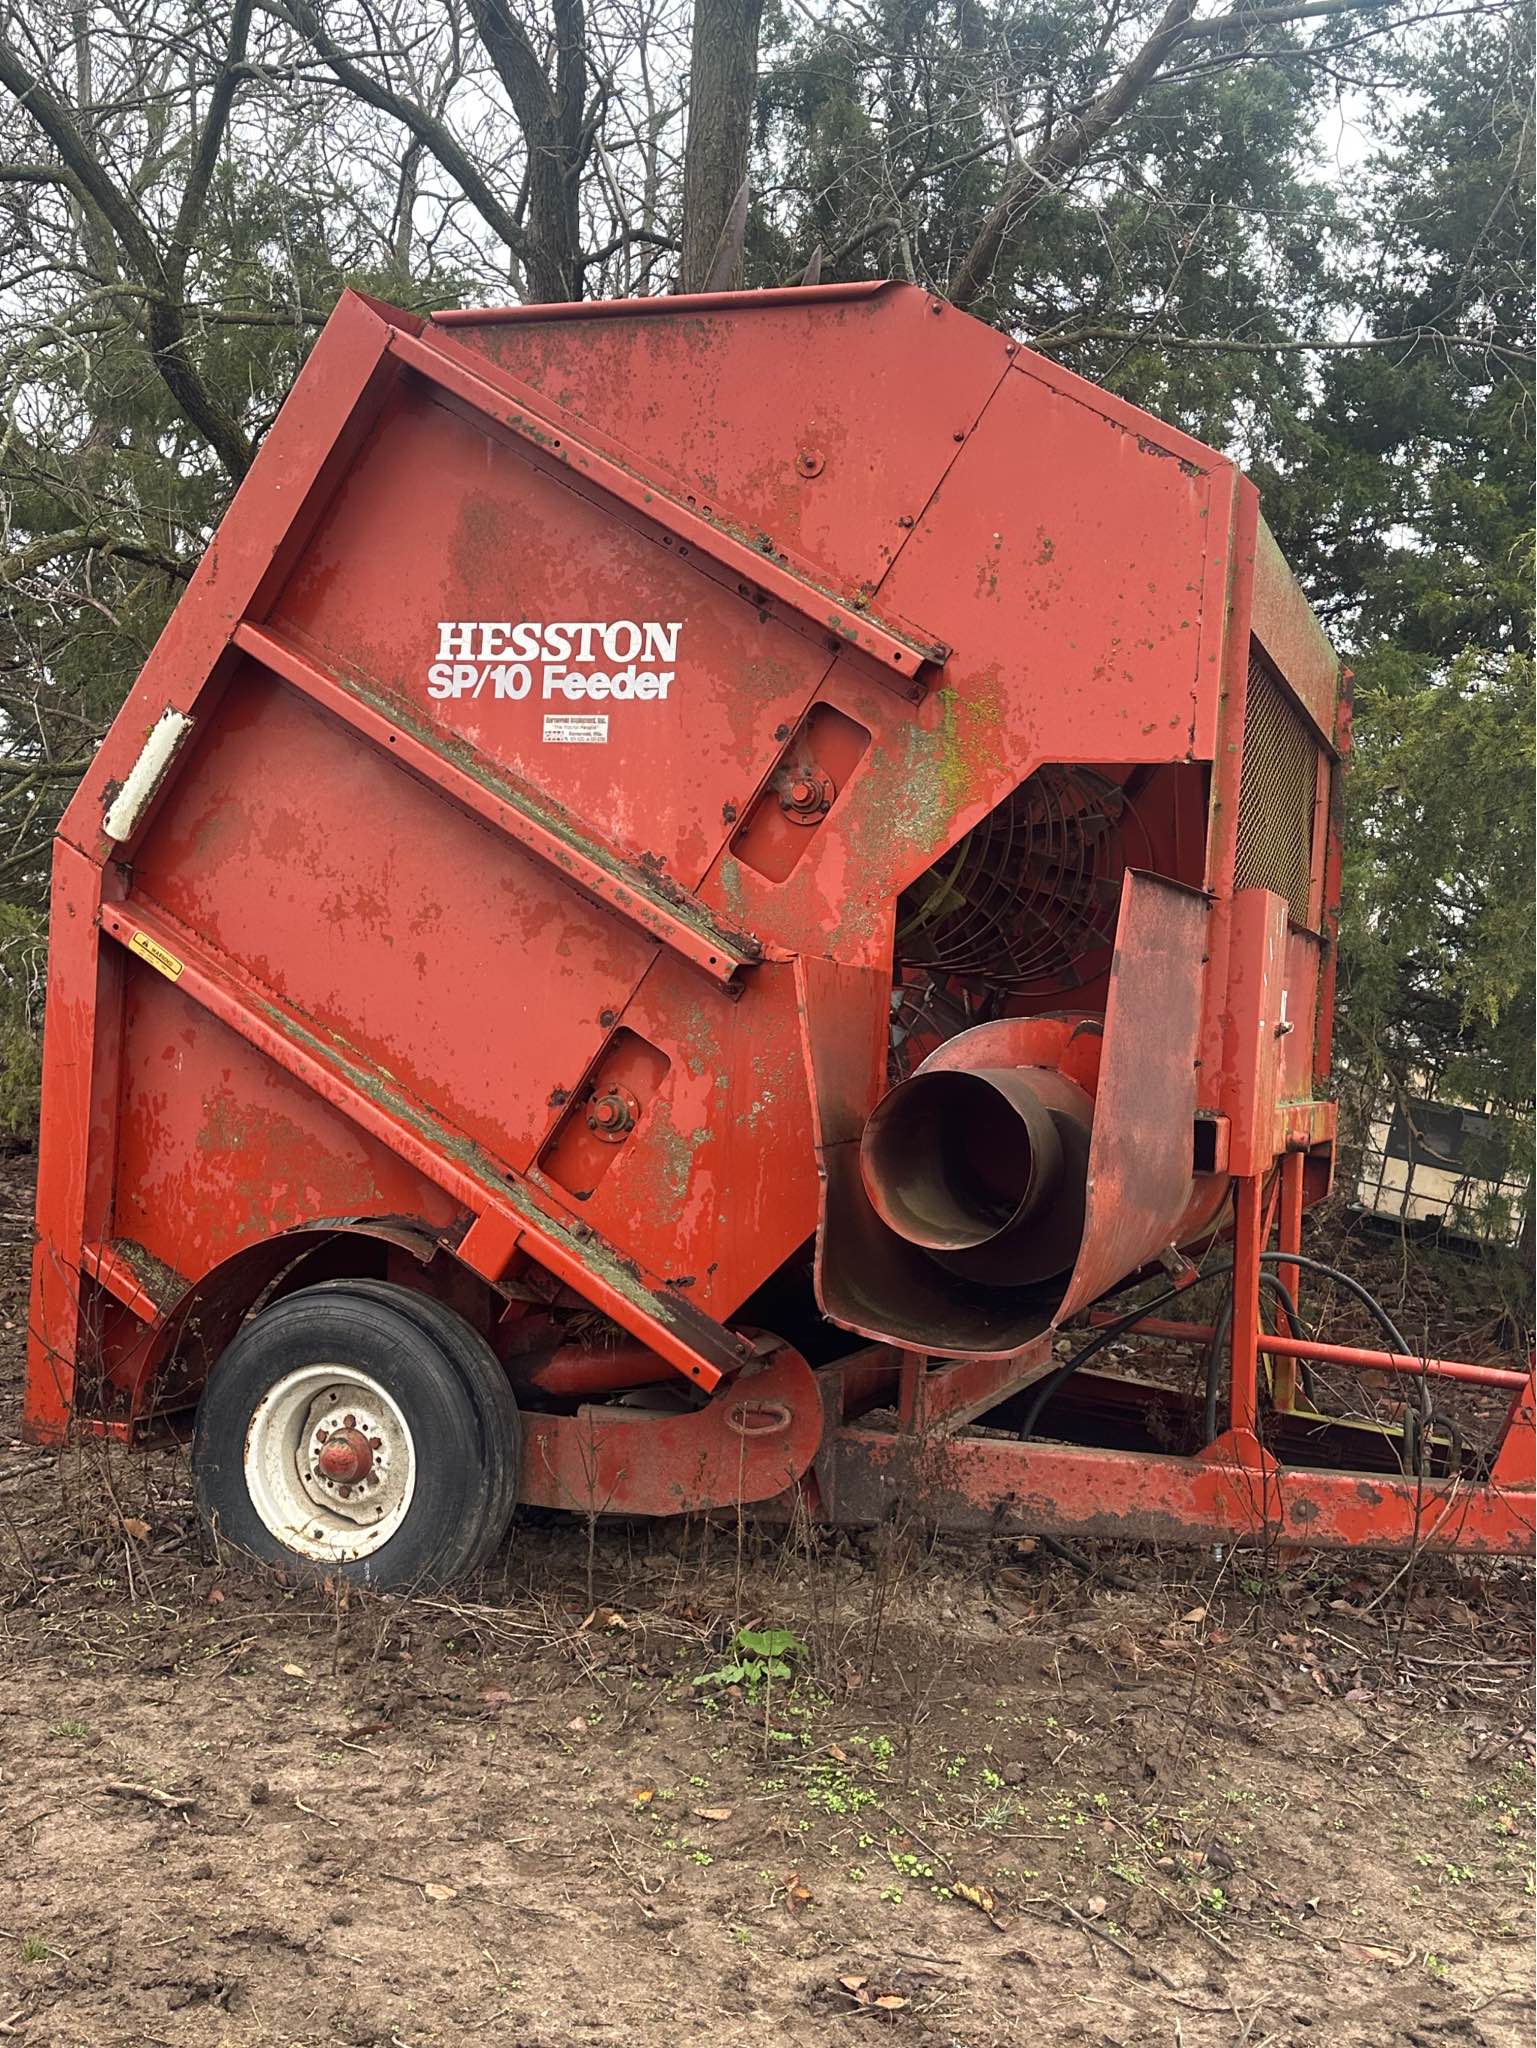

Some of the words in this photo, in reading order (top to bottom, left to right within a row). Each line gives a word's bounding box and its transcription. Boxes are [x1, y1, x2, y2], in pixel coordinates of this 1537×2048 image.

[435, 620, 683, 663] HESSTON
[427, 663, 532, 700] SP/10
[542, 664, 675, 700] Feeder
[151, 947, 174, 967] WARNING
